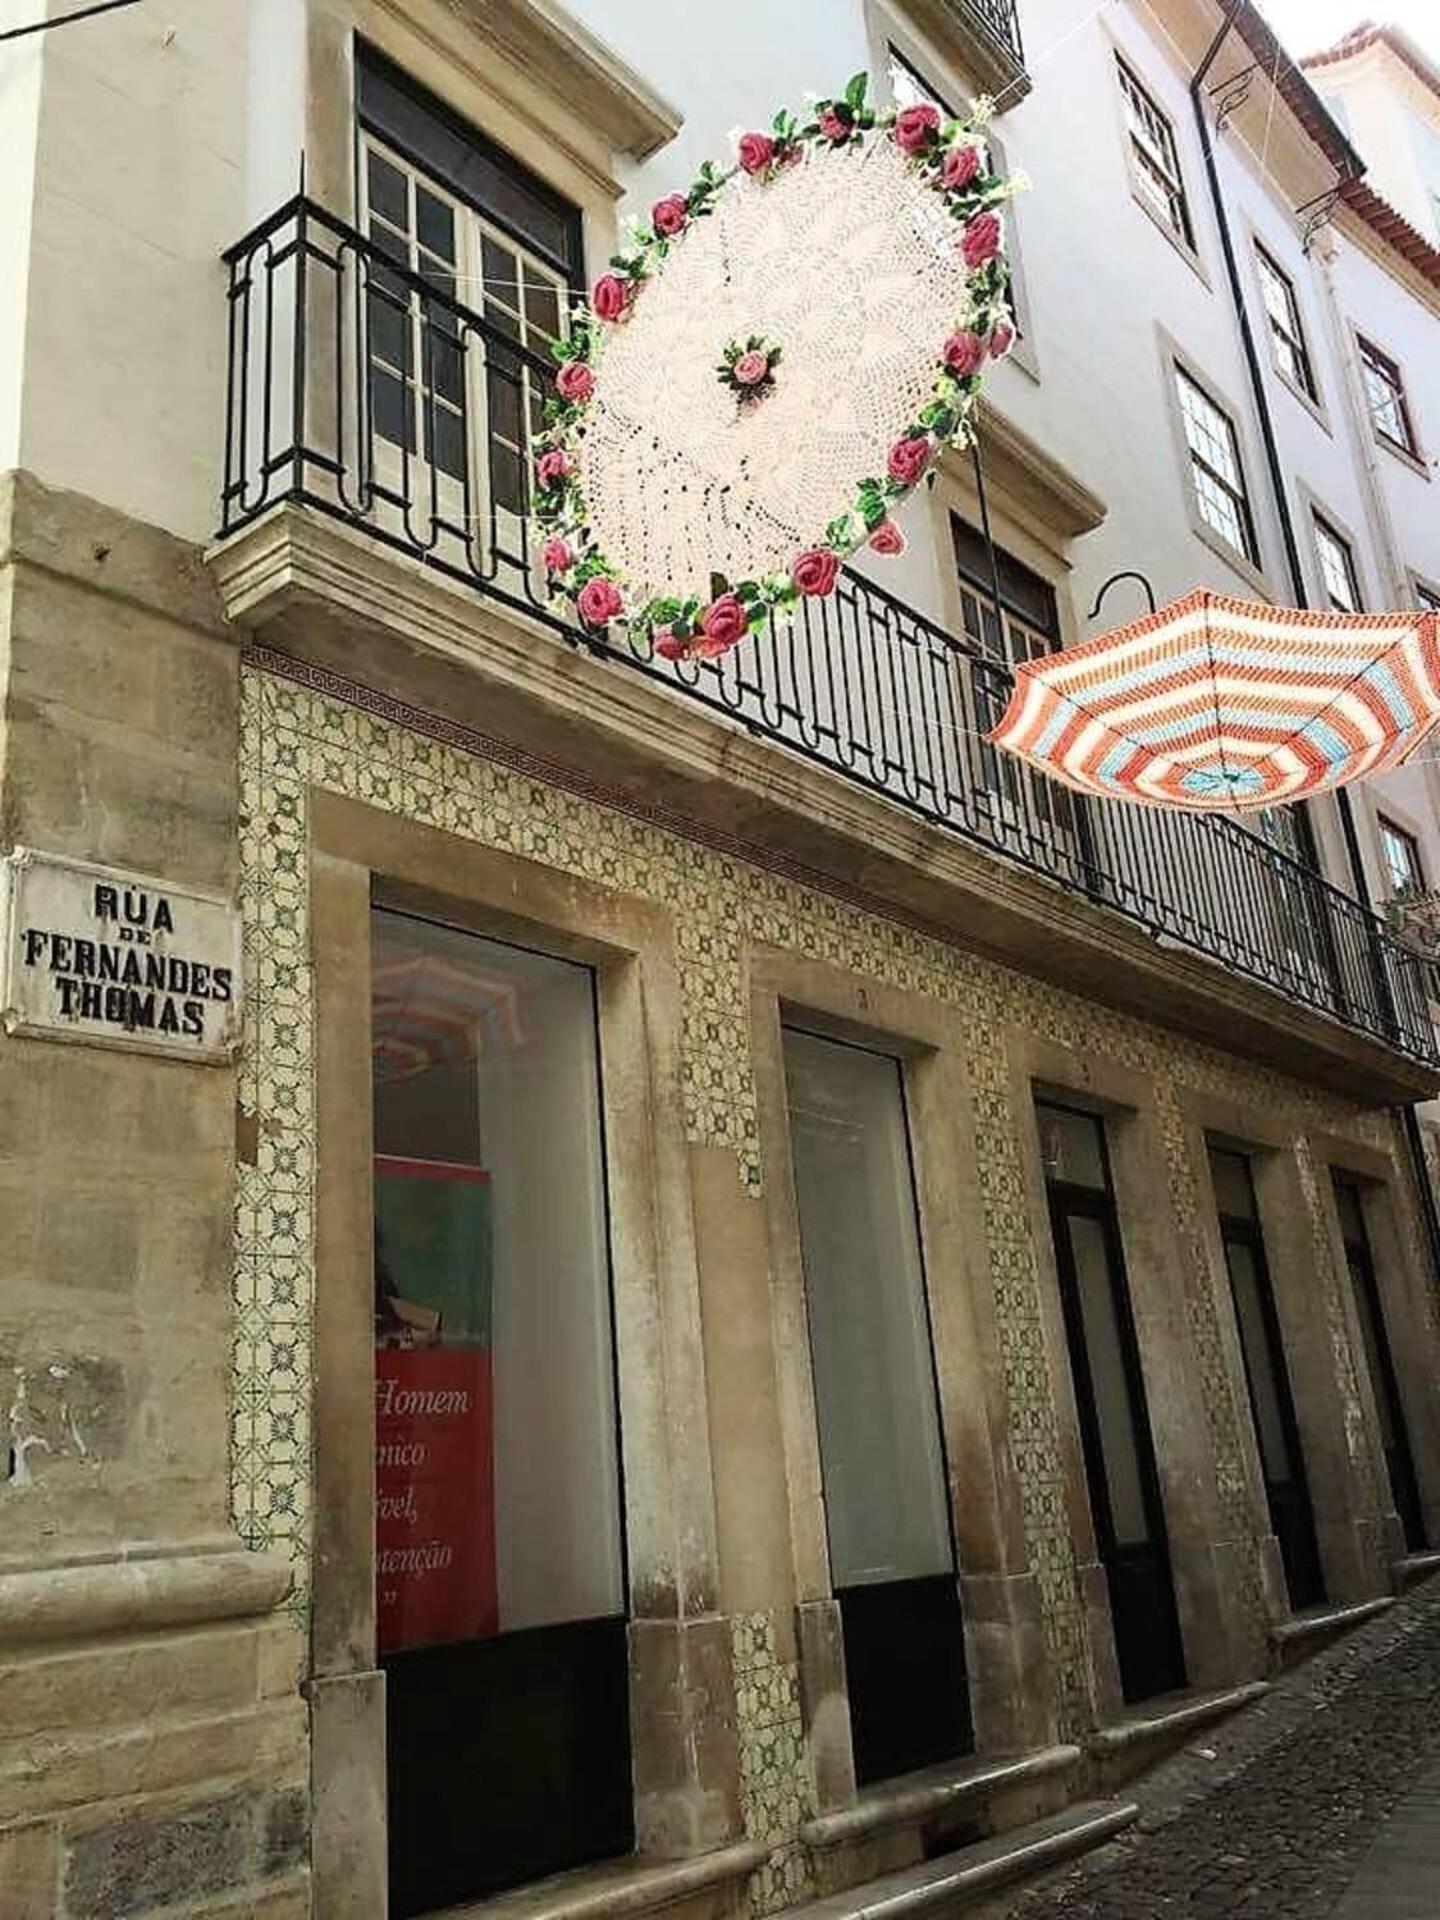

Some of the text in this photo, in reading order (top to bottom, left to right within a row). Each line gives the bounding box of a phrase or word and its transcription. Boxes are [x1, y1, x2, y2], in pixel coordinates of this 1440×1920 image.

[94, 883, 174, 933] RUA
[119, 926, 152, 946] DE
[24, 928, 232, 1002] FERNANDES
[55, 976, 204, 1036] THOMAS
